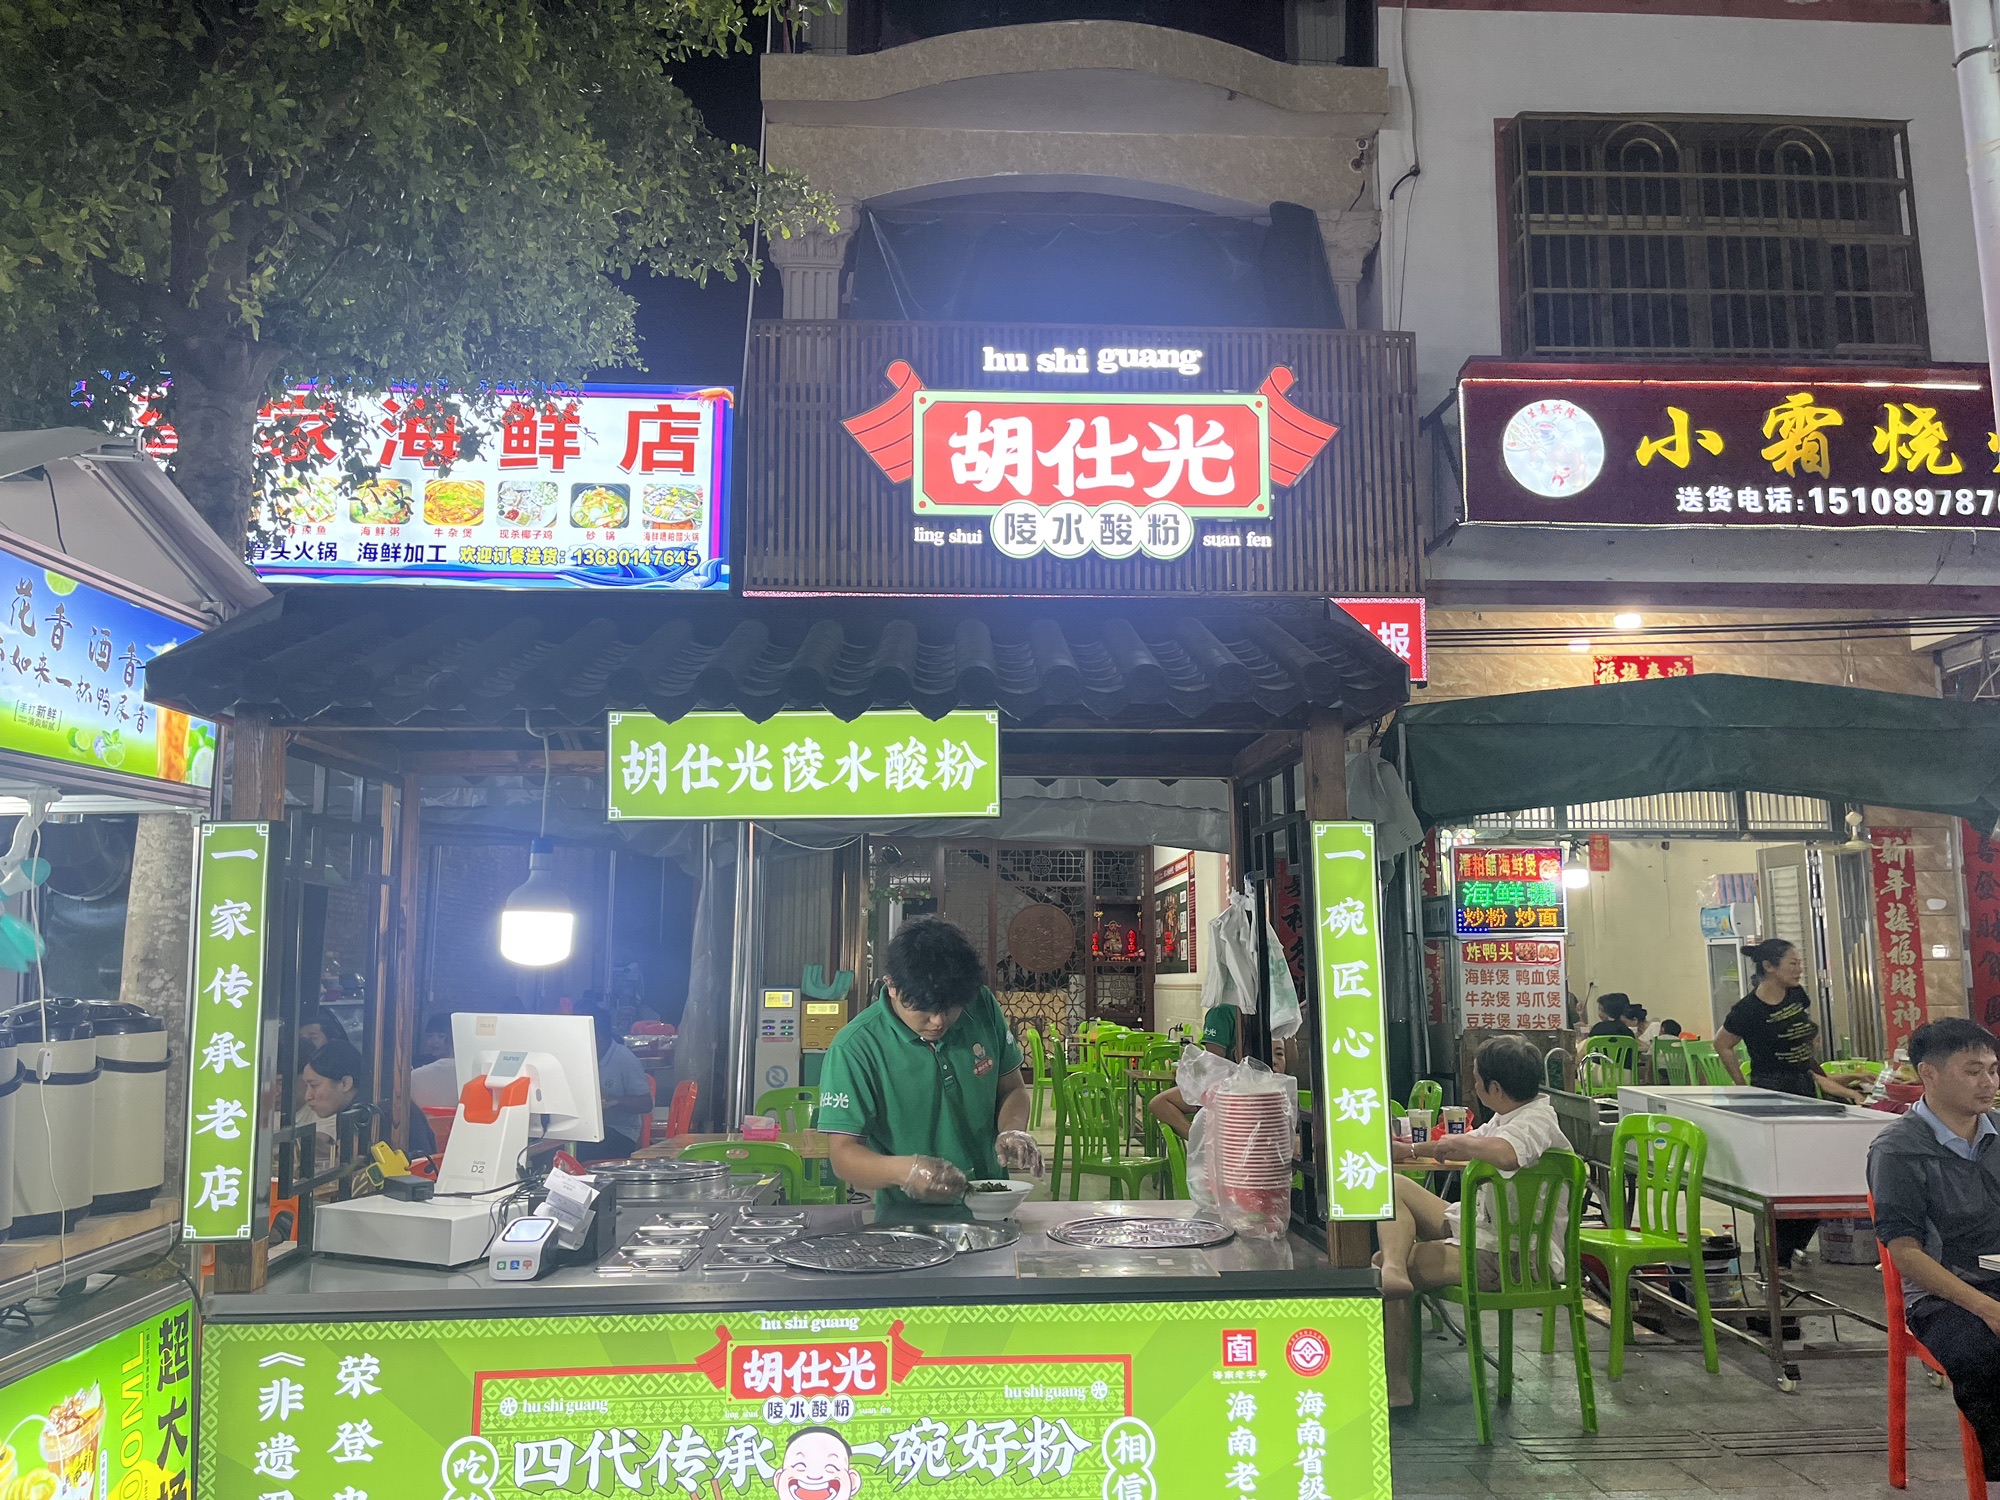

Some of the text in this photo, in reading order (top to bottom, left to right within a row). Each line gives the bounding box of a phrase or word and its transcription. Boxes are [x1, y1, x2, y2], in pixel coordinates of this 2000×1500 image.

[982, 346, 1202, 376] hu shi guang
[133, 393, 702, 475] 家海鲜店
[1636, 393, 2000, 479] 小霜烧
[948, 409, 1235, 498] 胡仕光
[1676, 486, 2000, 515] 送货电话:151089787
[360, 526, 400, 537] 海鲜粥
[434, 528, 472, 538] 牛杂煲
[499, 529, 553, 540] 现杀椰子鸡
[913, 512, 1272, 548] ling shui 陵水酸粉 suan fen
[357, 542, 448, 563] 海鲜加工
[10, 577, 143, 687] 花香酒香
[0, 636, 149, 734] 如来一杯鸭屎香
[620, 736, 988, 794] 胡仕光陵水酸粉
[1462, 881, 1557, 907] 海鲜粥
[1463, 907, 1559, 927] 炒粉 炒面
[1466, 942, 1514, 962] 炸鸭头
[1464, 968, 1561, 987] 海鲜煲 鸭血煲
[1465, 990, 1561, 1009] 牛杂煲 鸡爪煲
[193, 847, 259, 1213] 一家传承老店
[1322, 848, 1389, 1191] 一碗匠心好粉
[1466, 1012, 1562, 1031] 豆芽煲 鸡尖煲
[471, 1165, 484, 1174] D2
[760, 1315, 860, 1332] hu shi guang
[743, 1347, 876, 1394] 胡仕光
[1004, 1384, 1086, 1400] hu shi guang
[523, 1399, 608, 1415] hu shi guang
[767, 1399, 850, 1419] 陵水酸粉
[514, 1417, 1092, 1493] 四代传承 一碗好粉
[1225, 1390, 1260, 1500] 海南老
[1293, 1388, 1332, 1500] 海南省级
[453, 1450, 489, 1500] 吃
